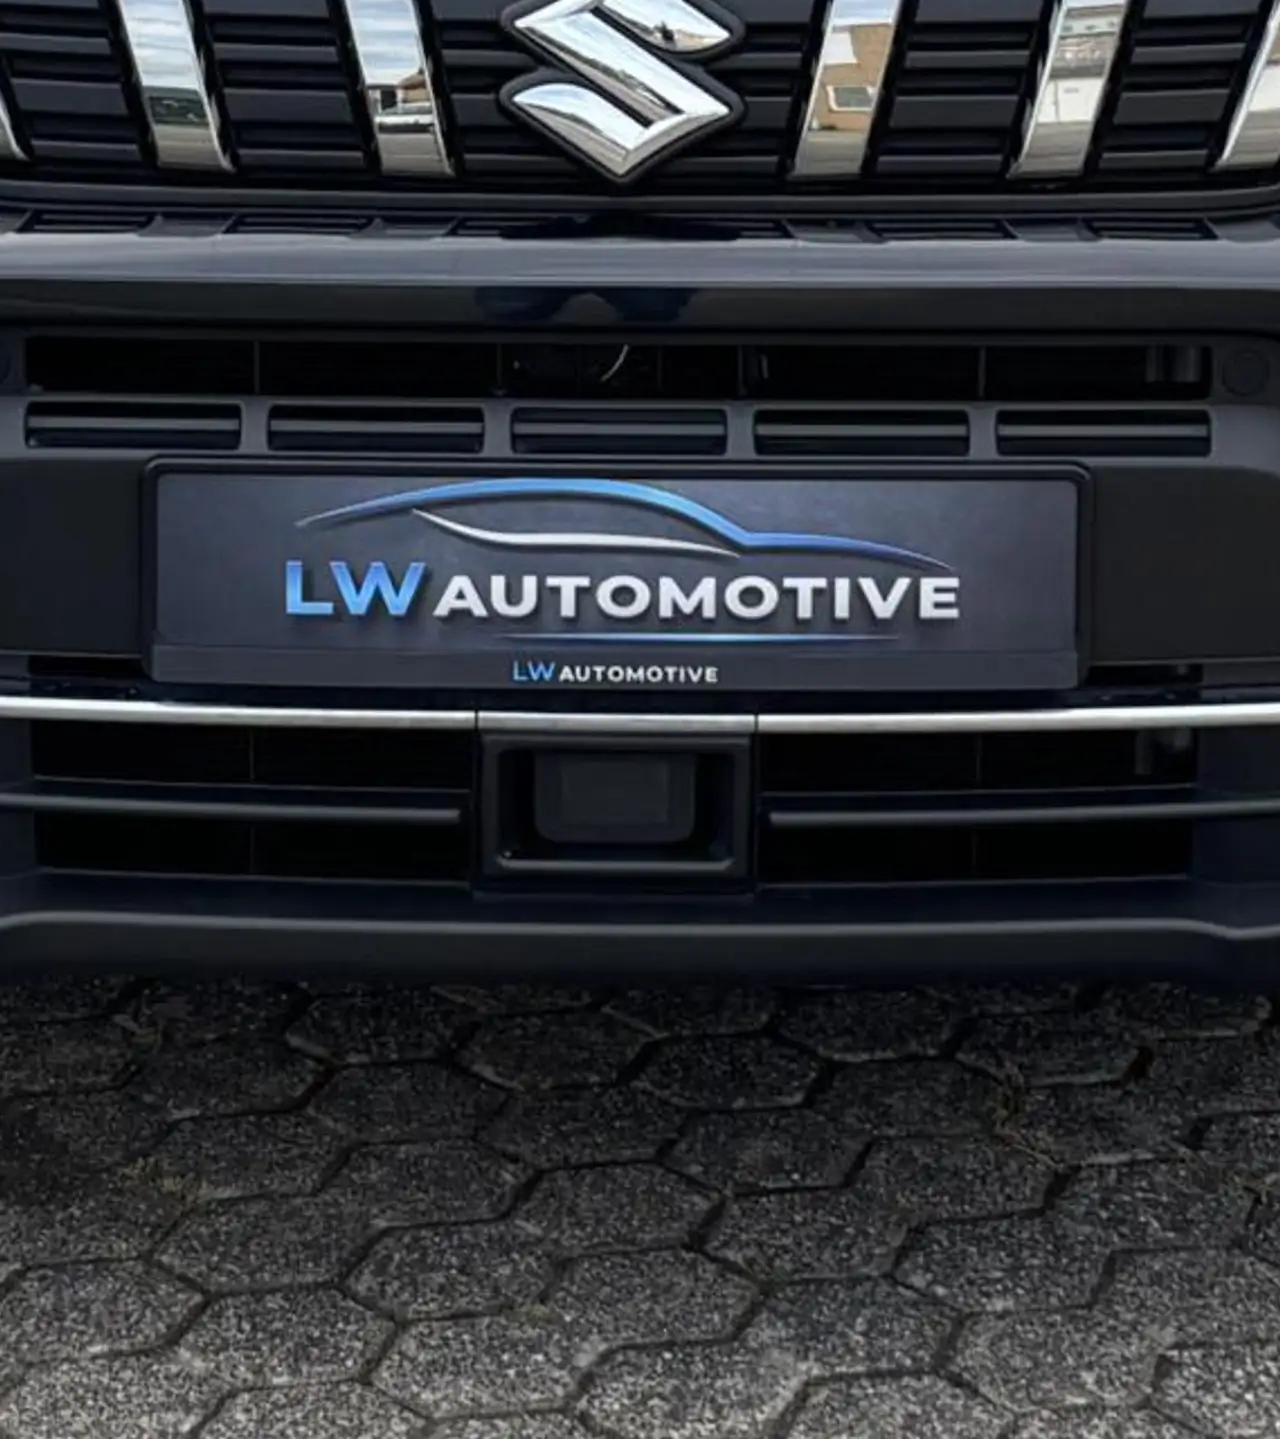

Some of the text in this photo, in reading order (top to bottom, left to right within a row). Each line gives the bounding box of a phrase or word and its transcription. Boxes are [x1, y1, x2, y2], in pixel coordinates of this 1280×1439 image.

[285, 560, 960, 620] LW AUTOMOTIVE
[513, 661, 719, 683] LW AUTOMOTIVE
